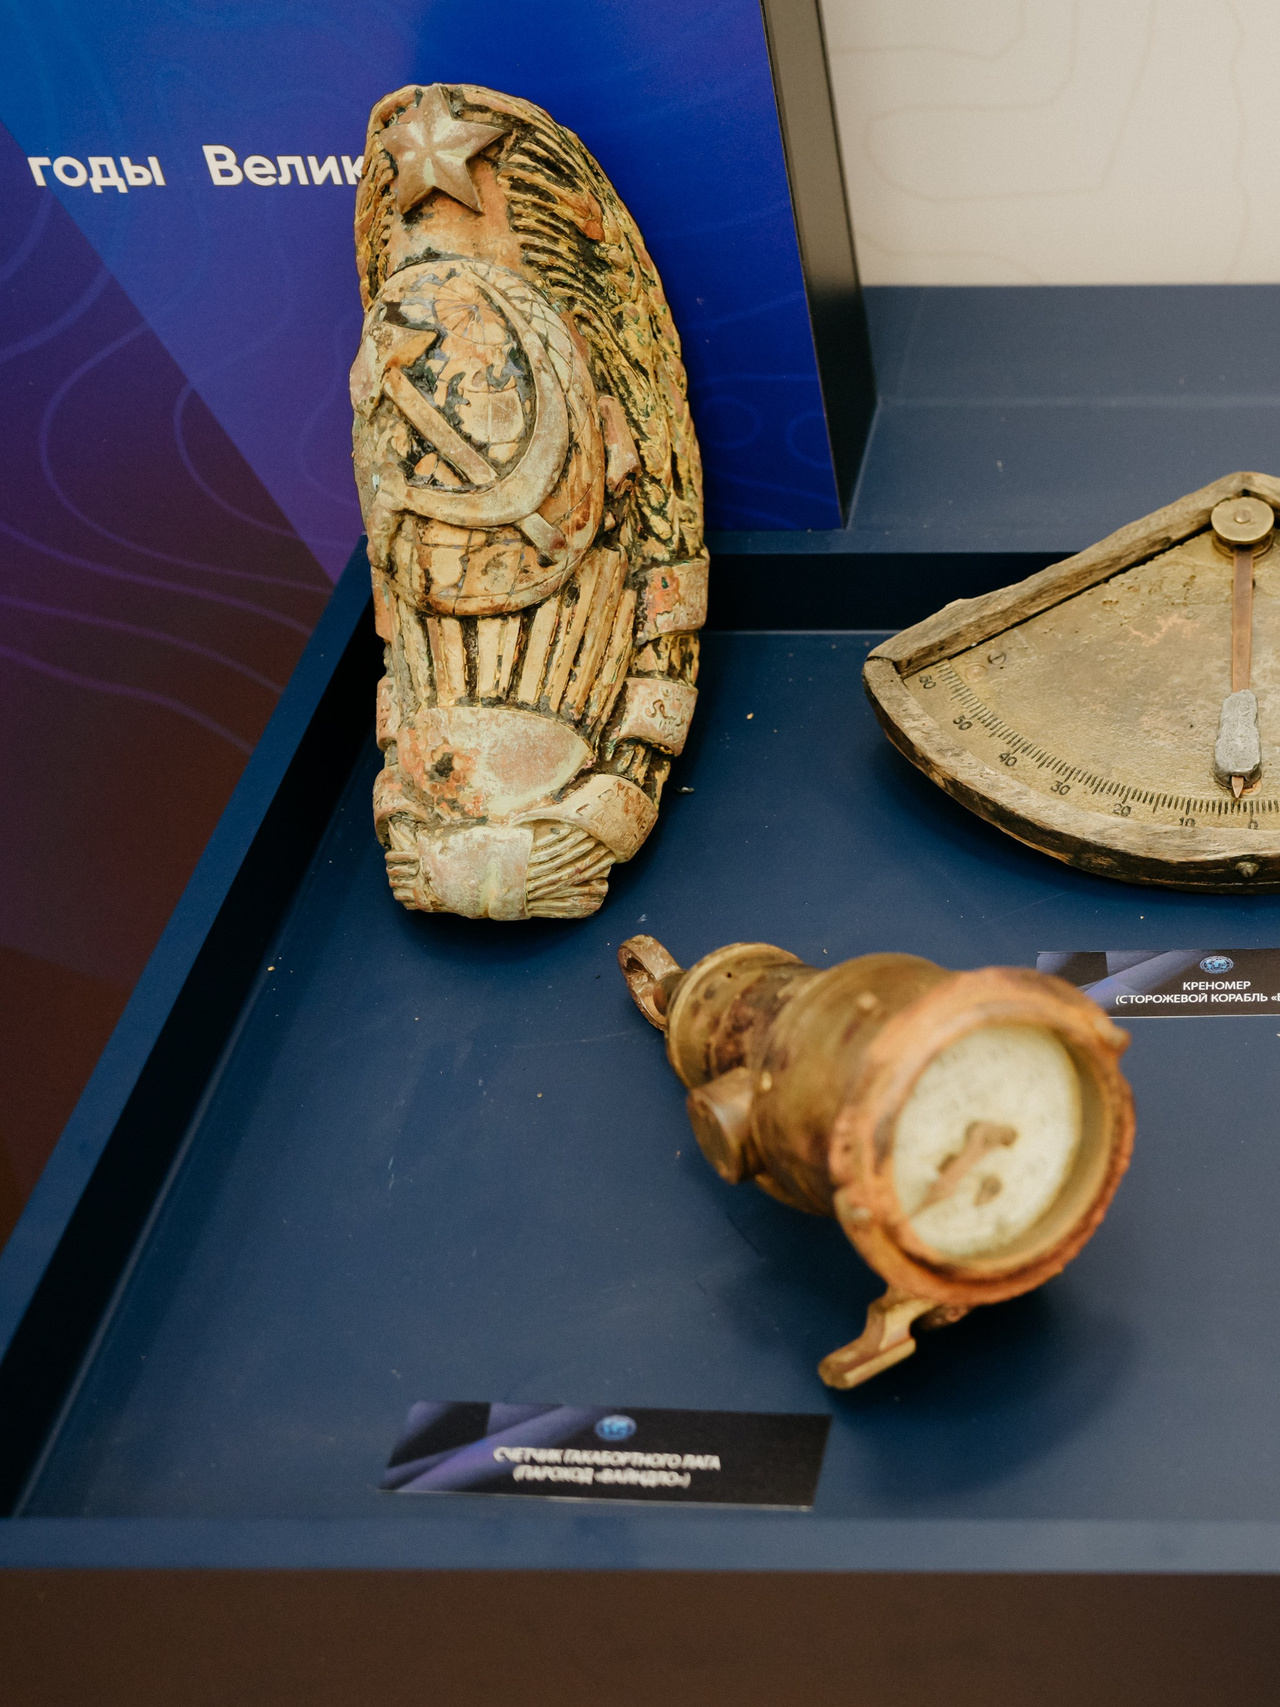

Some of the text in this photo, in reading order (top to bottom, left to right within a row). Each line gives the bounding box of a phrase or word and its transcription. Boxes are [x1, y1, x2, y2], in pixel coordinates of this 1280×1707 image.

[27, 144, 366, 193] годы Велик
[999, 751, 1018, 767] 40
[1050, 780, 1071, 796] 30
[1112, 803, 1132, 817] 20
[1178, 816, 1196, 827] 10
[1115, 992, 1208, 1006] (СТОРОЖЕВОЙ
[1210, 993, 1268, 1003] КОРАБЛЬ
[1182, 980, 1252, 991] КРЕНОМЕР
